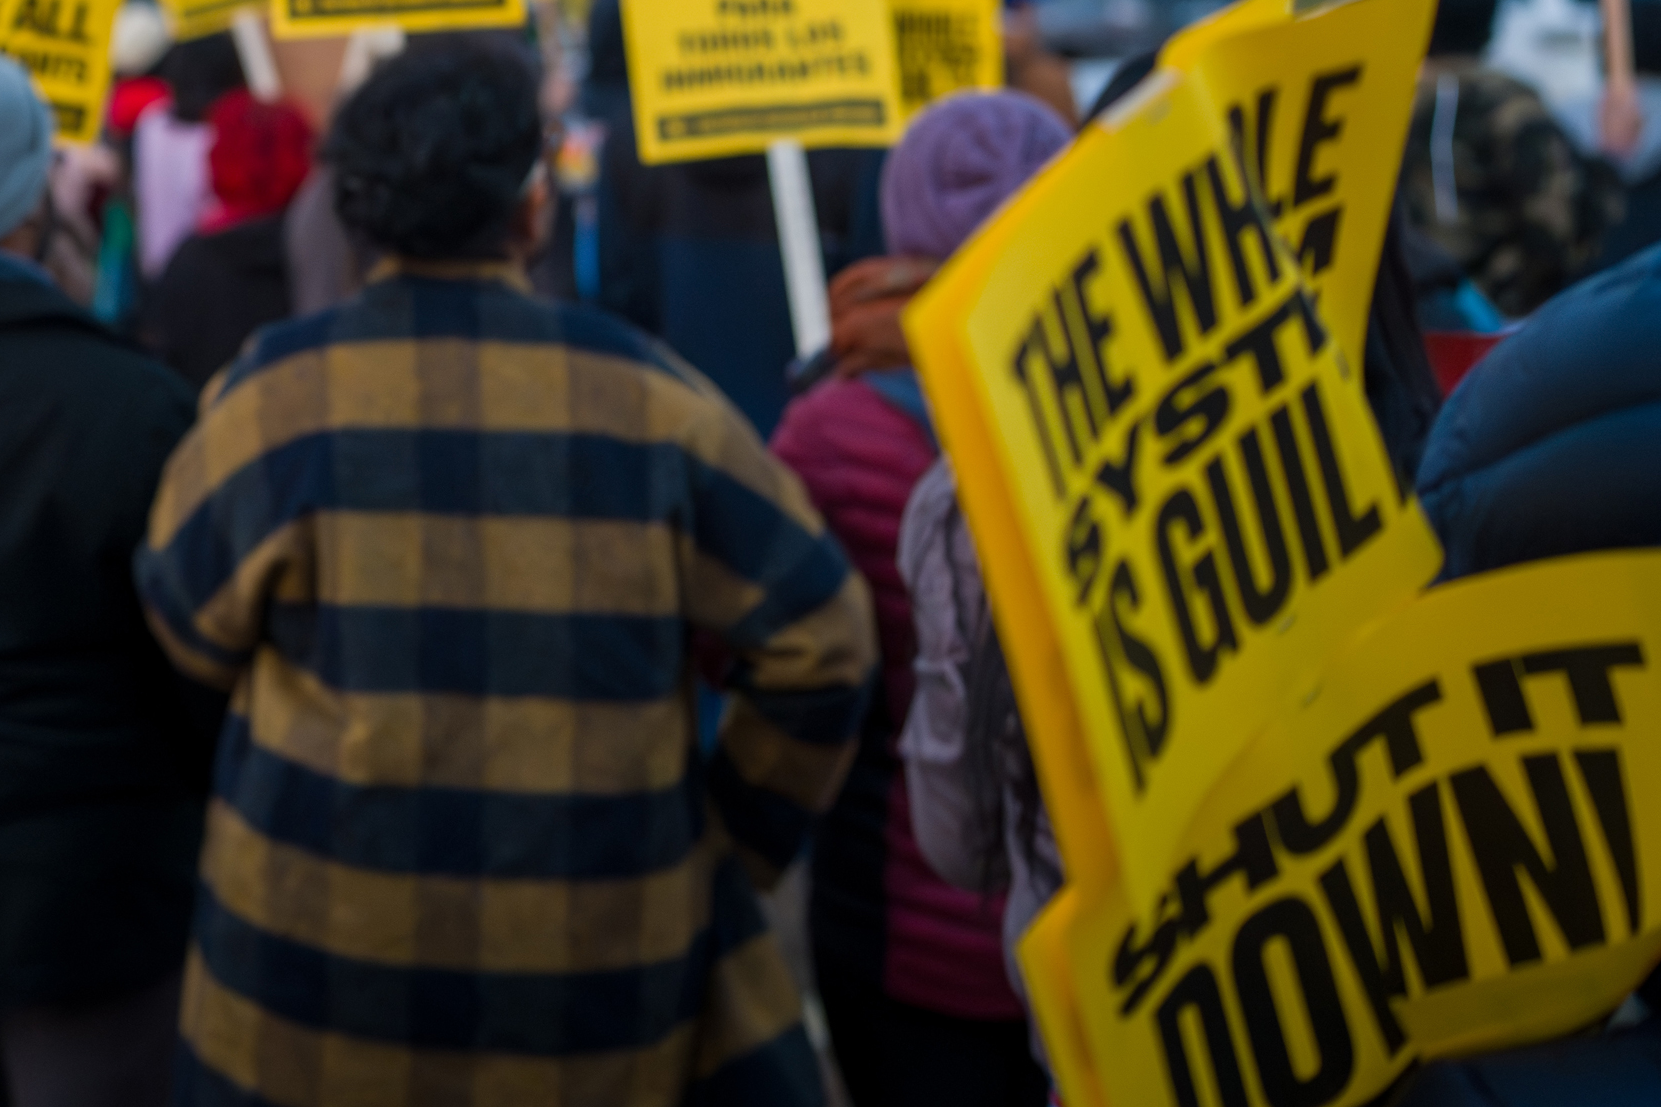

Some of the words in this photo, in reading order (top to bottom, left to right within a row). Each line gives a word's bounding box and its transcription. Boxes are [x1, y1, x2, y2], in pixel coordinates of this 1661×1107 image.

[1007, 242, 1137, 500] THE
[1114, 60, 1366, 368] WHLE
[1091, 555, 1174, 801] IS
[1153, 378, 1385, 689] GUIL
[1109, 675, 1445, 1022] SHUT
[1469, 640, 1647, 741] IT
